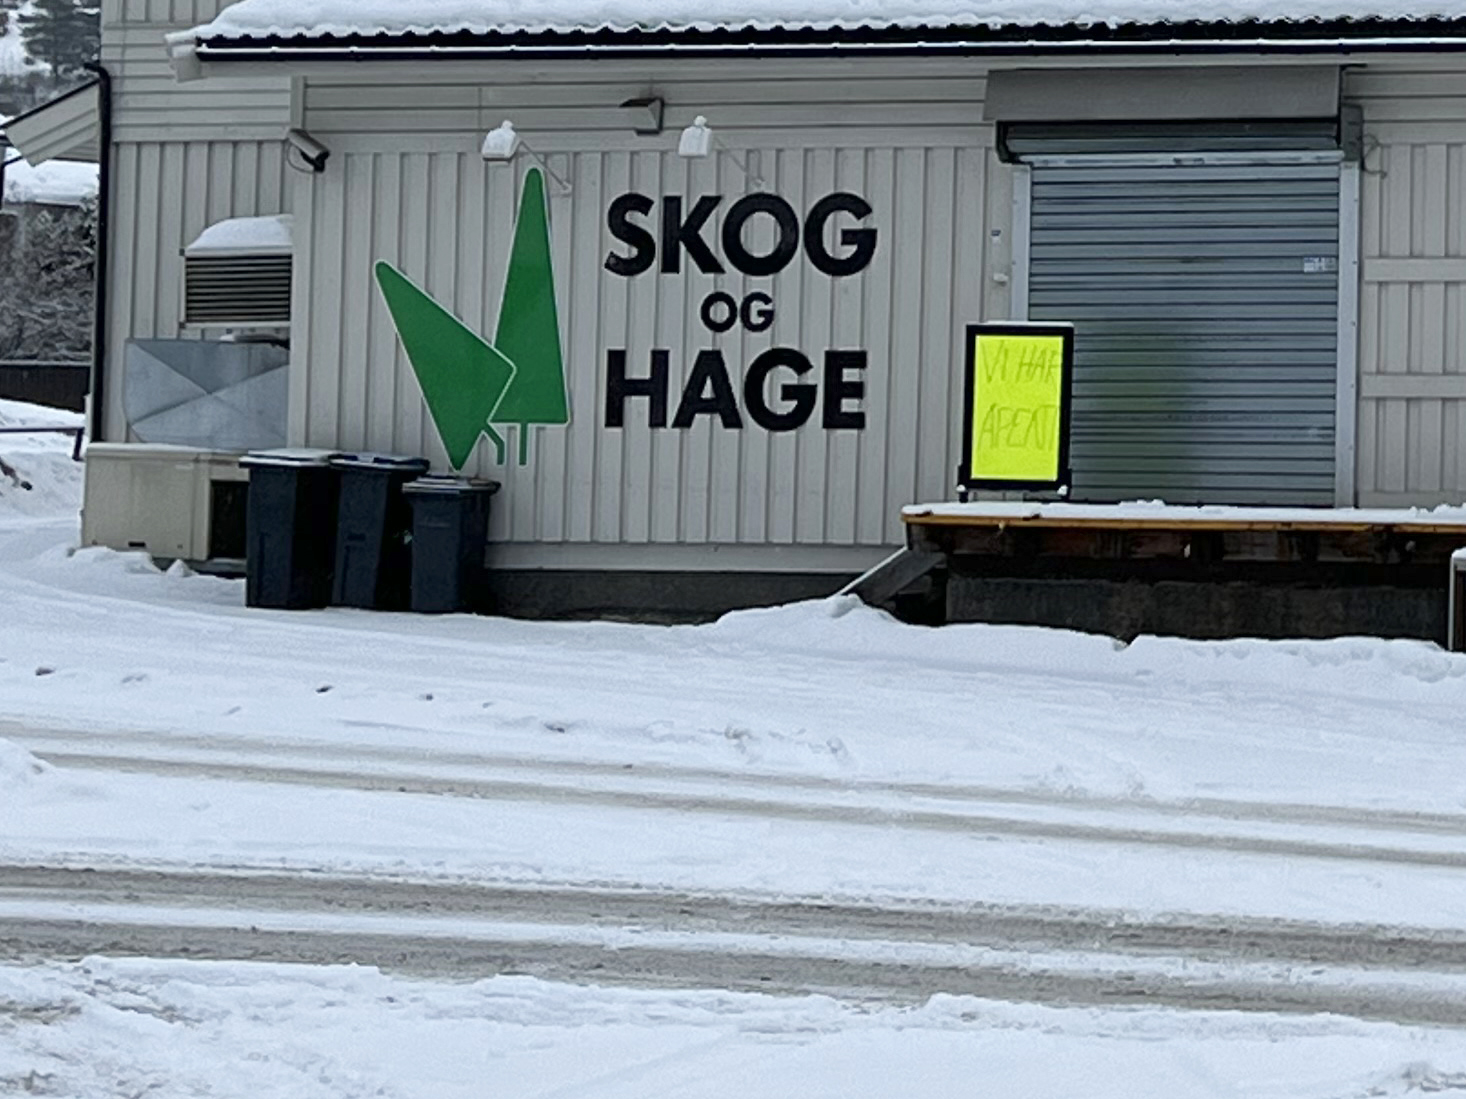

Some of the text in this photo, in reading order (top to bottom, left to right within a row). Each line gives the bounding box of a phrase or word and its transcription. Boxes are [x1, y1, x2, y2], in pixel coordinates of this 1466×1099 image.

[604, 192, 878, 277] SKOG
[700, 291, 775, 333] OG
[604, 347, 867, 432] HAGE
[981, 339, 1009, 384] VI
